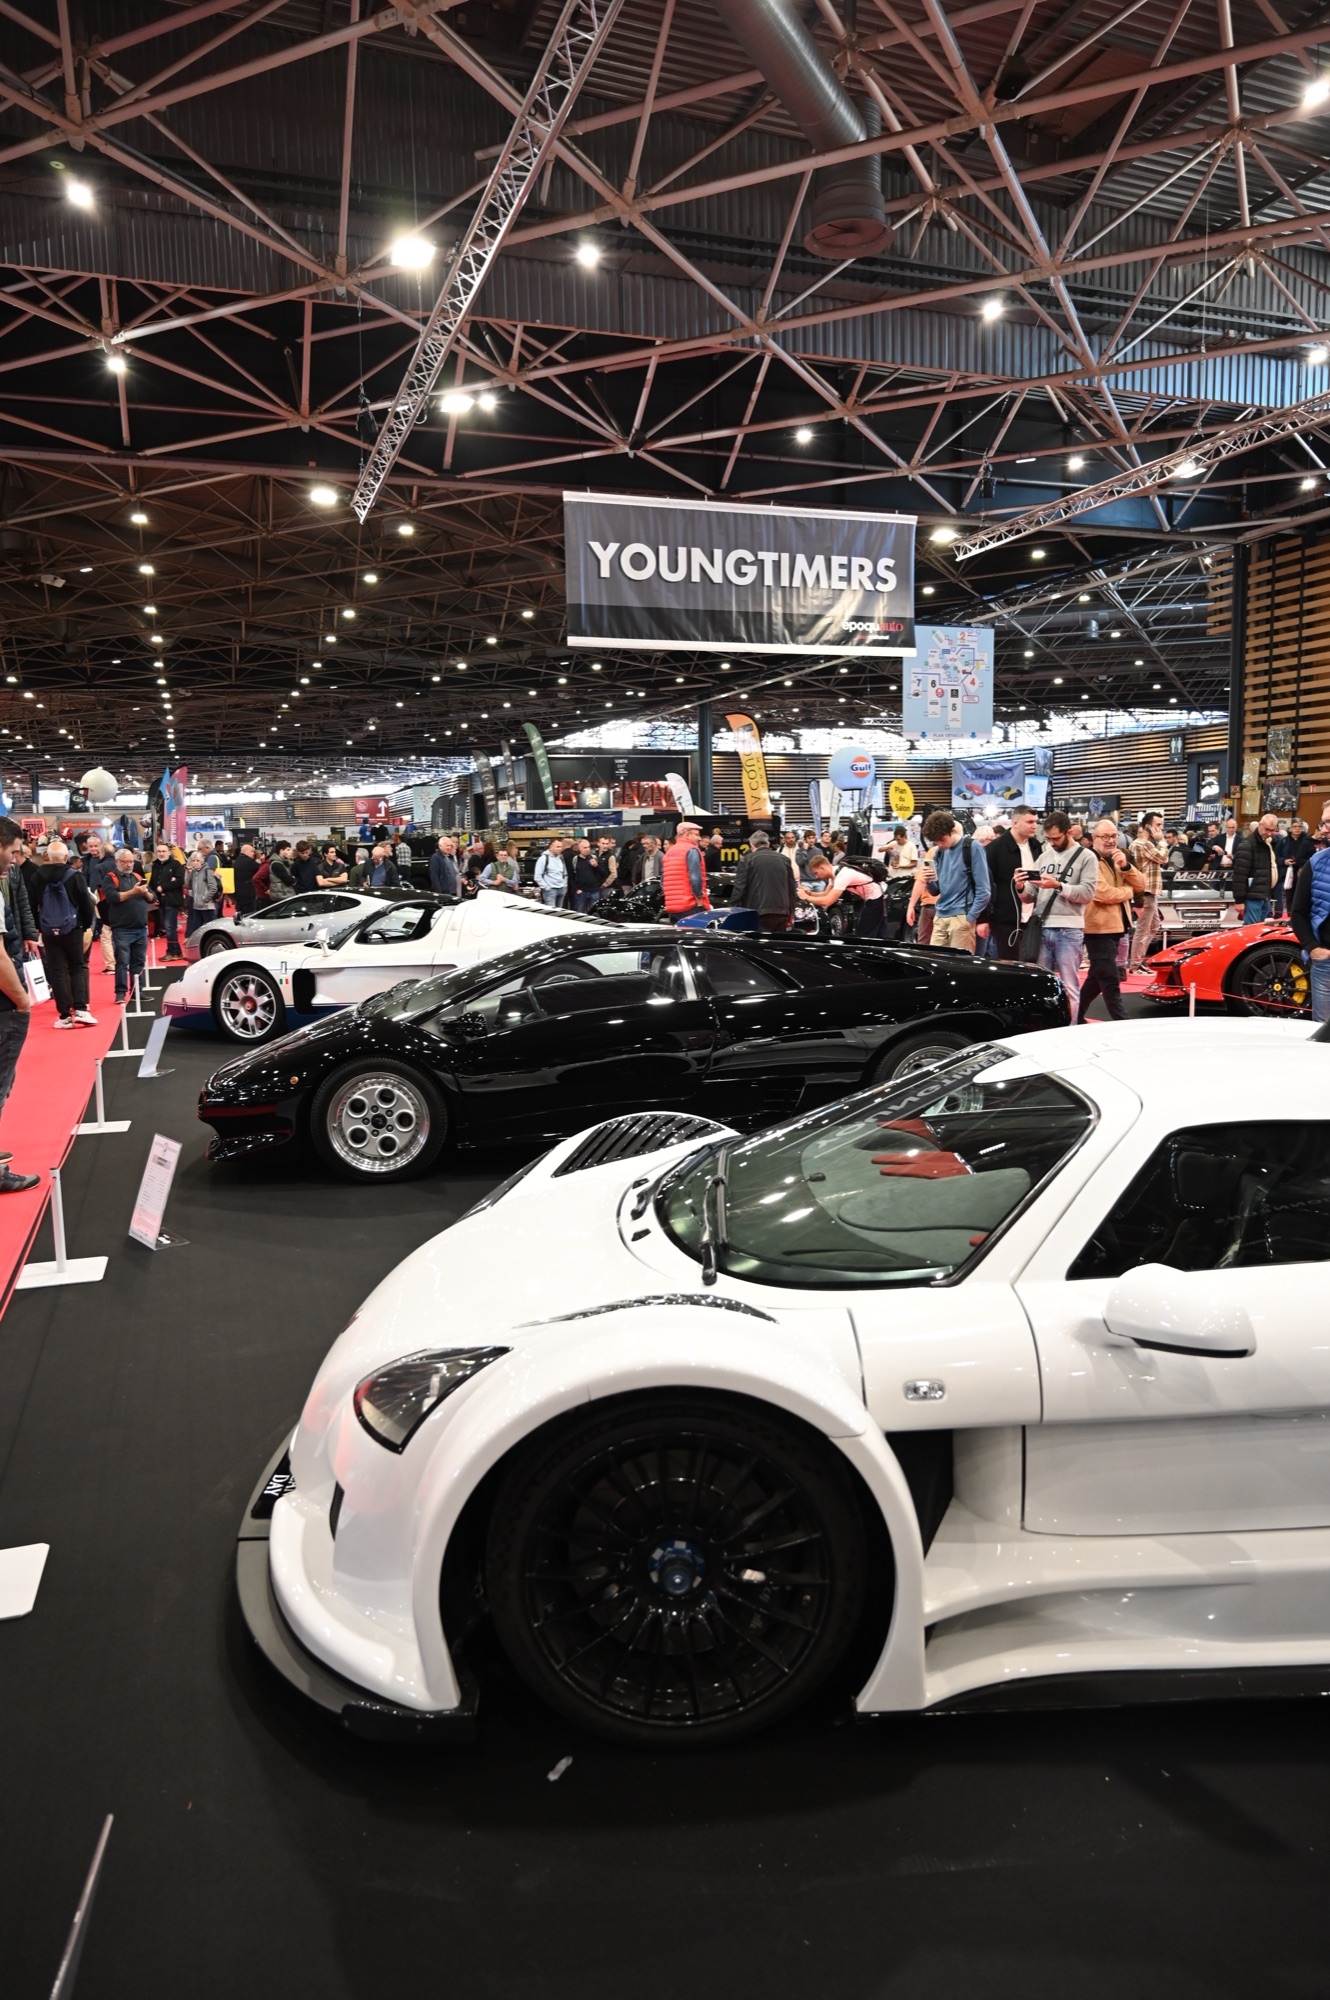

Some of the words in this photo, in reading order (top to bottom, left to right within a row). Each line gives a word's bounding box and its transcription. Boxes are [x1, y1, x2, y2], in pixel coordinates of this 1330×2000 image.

[588, 541, 897, 592] YOUNGTIMERS
[960, 632, 966, 641] 2
[916, 679, 922, 687] 7
[931, 680, 937, 688] 6
[970, 678, 976, 687] 4
[952, 703, 957, 711] 5
[895, 804, 910, 812] Salon
[1173, 871, 1217, 880] Mobil
[264, 1475, 290, 1496] DAY
